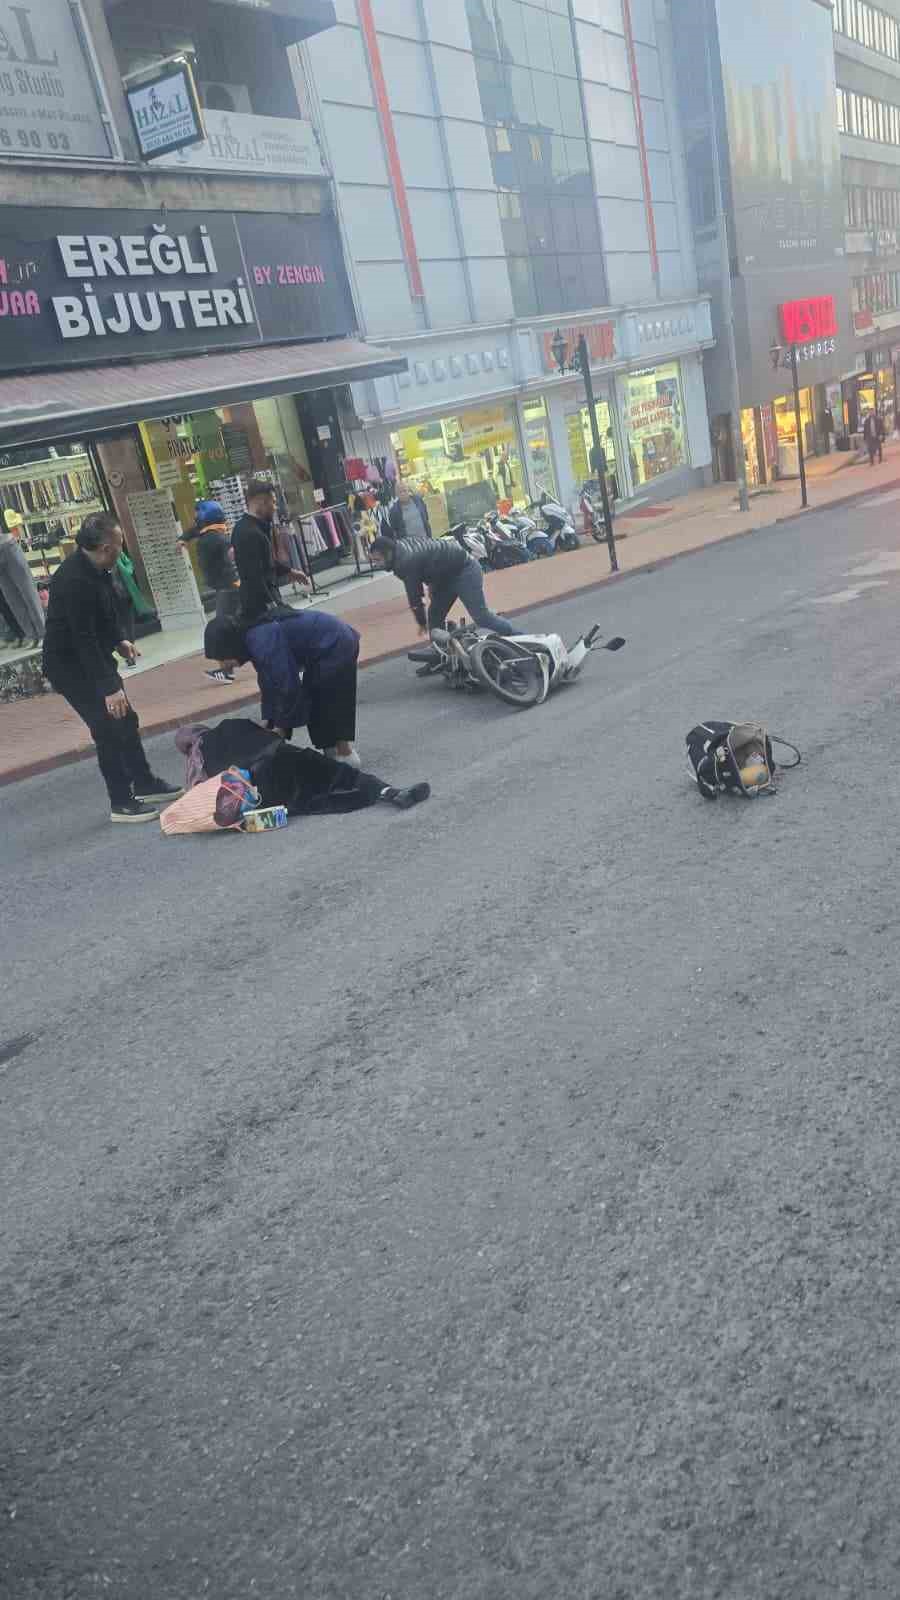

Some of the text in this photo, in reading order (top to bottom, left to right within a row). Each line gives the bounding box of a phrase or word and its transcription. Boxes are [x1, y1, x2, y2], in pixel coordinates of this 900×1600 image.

[15, 69, 65, 98] Studio
[47, 131, 71, 151] 03
[56, 223, 218, 278] EREĞLİ
[254, 265, 273, 285] BY
[51, 277, 254, 338] BİJUTERİ
